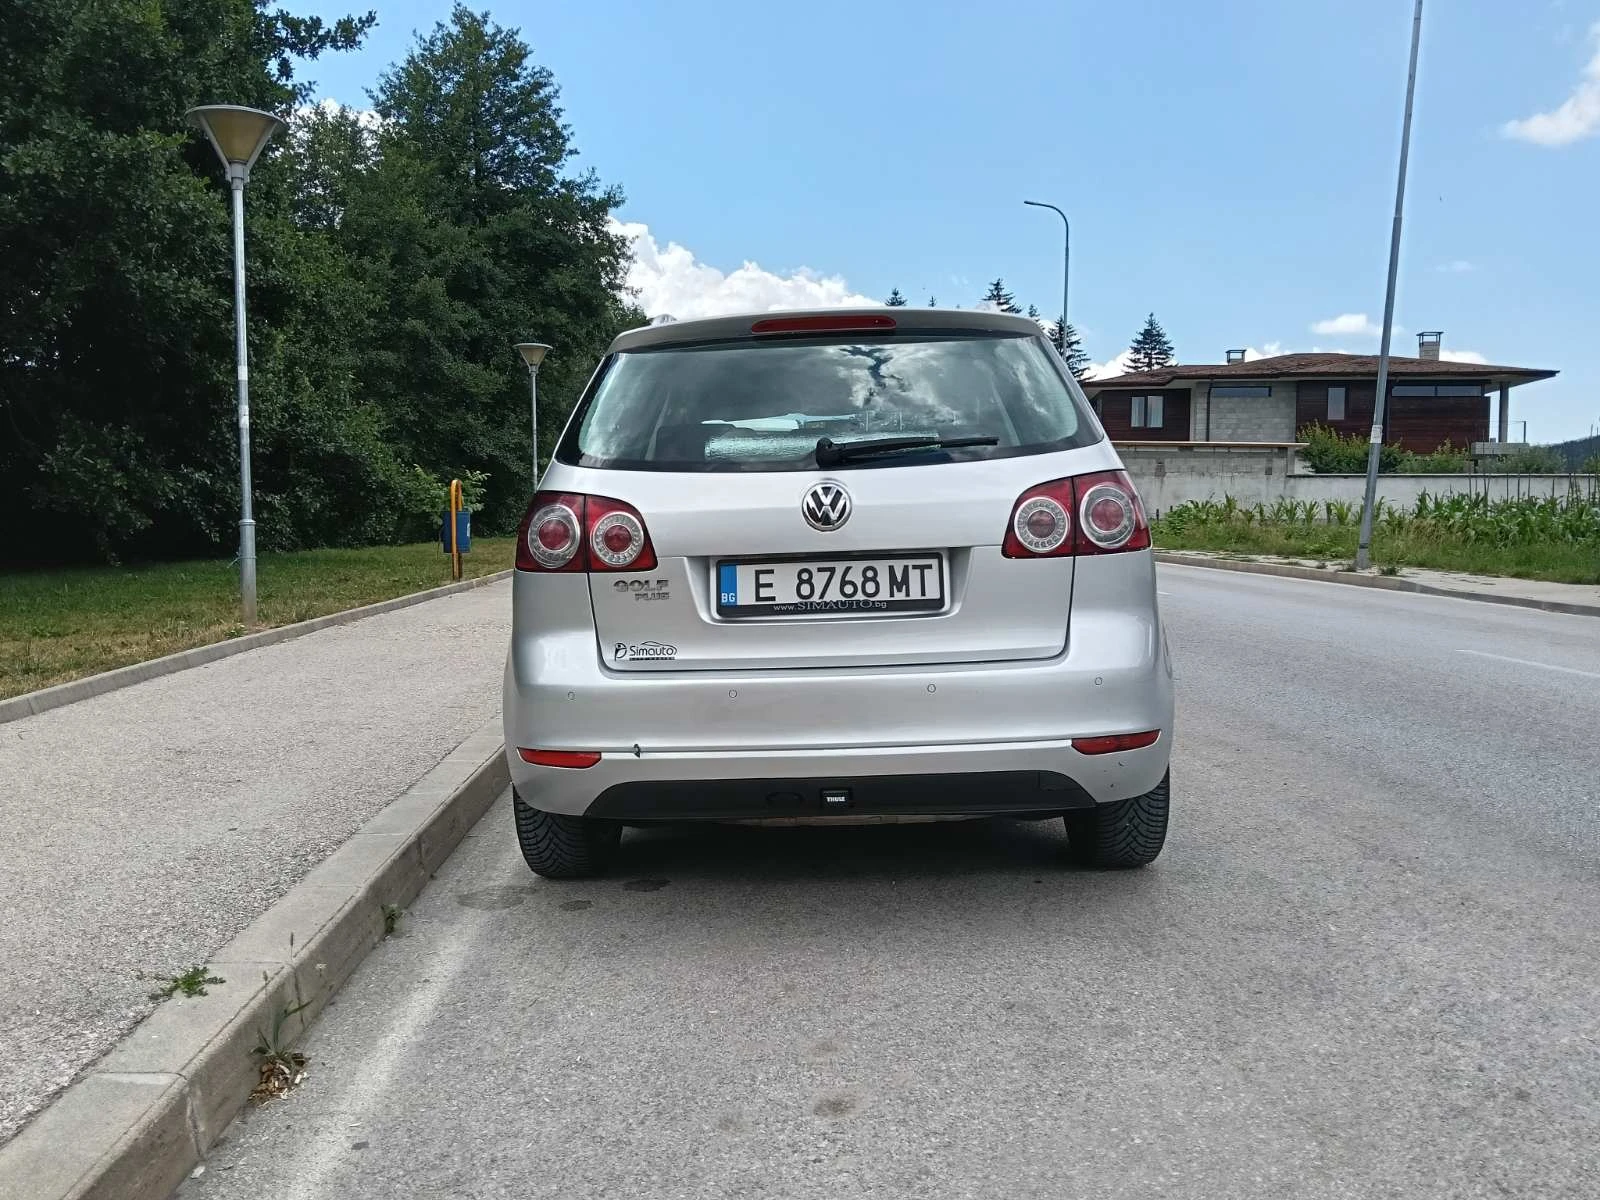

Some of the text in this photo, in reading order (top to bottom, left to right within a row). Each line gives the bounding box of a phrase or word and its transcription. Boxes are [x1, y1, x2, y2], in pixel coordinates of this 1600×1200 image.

[804, 483, 850, 530] VW
[613, 579, 669, 592] GOLF
[754, 563, 933, 602] E 8768 MT
[721, 592, 736, 603] BG
[773, 598, 888, 611] www.SIMAUTO.bg
[629, 645, 674, 656] Simauto
